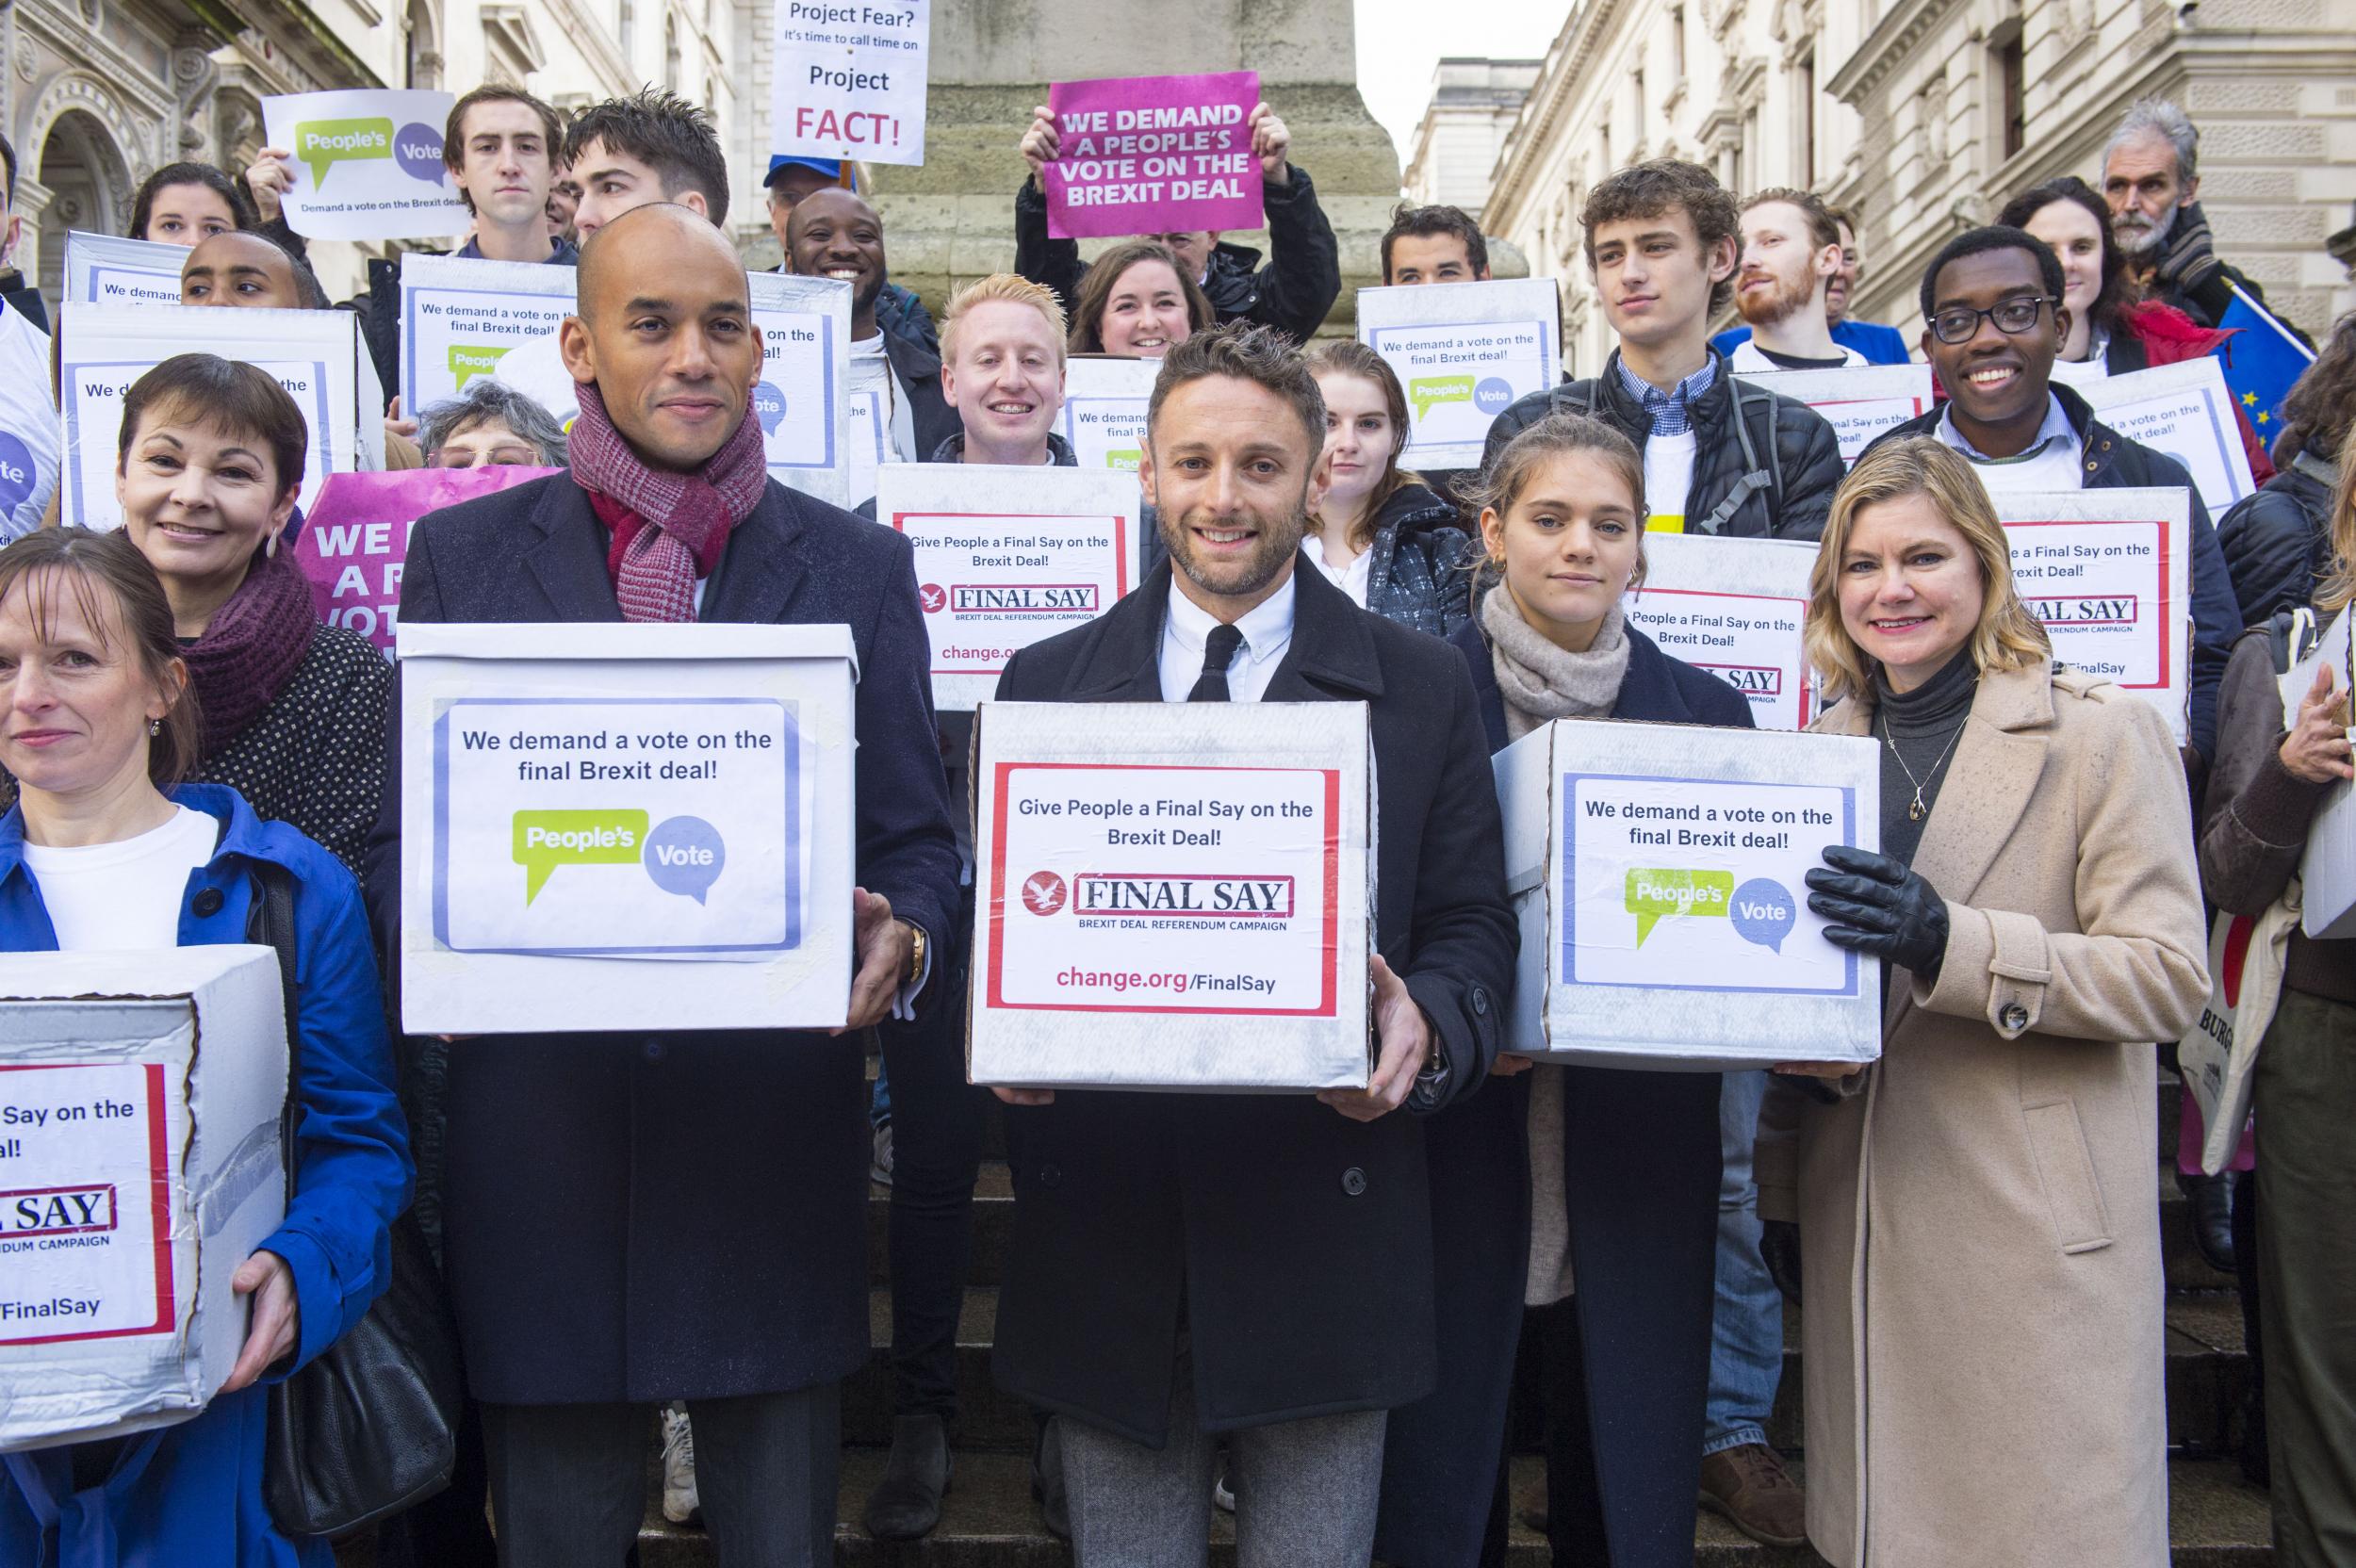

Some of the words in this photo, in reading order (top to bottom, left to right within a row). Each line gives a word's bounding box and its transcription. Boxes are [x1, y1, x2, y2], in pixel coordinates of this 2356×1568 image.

[791, 3, 856, 24] Project
[863, 8, 914, 27] Fear?
[785, 29, 801, 40] It's
[806, 30, 831, 42] time
[836, 34, 846, 44] to
[850, 36, 869, 45] call
[874, 37, 899, 48] time
[904, 41, 918, 50] on
[810, 66, 889, 91] Project
[796, 107, 899, 146] FACT!
[1062, 112, 1108, 133] WE
[1116, 105, 1242, 131] DEMAND
[305, 131, 385, 151] People's
[402, 143, 442, 159] Vote
[1074, 138, 1097, 156] A
[1104, 130, 1231, 155] PEOPLE'S
[1058, 159, 1136, 182] VOTE
[1143, 156, 1186, 177] ON
[1194, 154, 1249, 174] THE
[1067, 182, 1164, 206] BREXIT
[1171, 178, 1245, 201] DEAL
[302, 204, 343, 212] Demand
[354, 202, 376, 210] vote
[394, 200, 410, 208] the
[413, 198, 441, 208] Brexit
[444, 197, 466, 206] dea
[105, 285, 125, 296] We
[422, 303, 442, 314] We
[446, 305, 497, 318] demand
[514, 310, 539, 320] vote
[450, 321, 478, 332] final
[483, 322, 520, 334] Brexit
[767, 330, 786, 340] on
[792, 329, 814, 341] the
[1383, 342, 1401, 351] We
[1406, 339, 1452, 351] demand
[1467, 337, 1493, 347] vote
[1497, 336, 1511, 345] on
[1515, 335, 1533, 344] the
[763, 348, 780, 358] al!
[1411, 354, 1436, 365] final
[1440, 352, 1475, 363] Brexit
[1479, 351, 1507, 361] deal!
[86, 384, 112, 397] We
[1417, 384, 1469, 397] People's
[1479, 391, 1508, 401] Vote
[755, 400, 779, 412] ote
[2130, 415, 2157, 426] vote
[2161, 411, 2176, 419] on
[2181, 405, 2201, 416] the
[1079, 414, 1098, 422] We
[1853, 418, 1871, 427] Say
[1891, 415, 1909, 423] the
[1107, 428, 1133, 436] final
[2146, 424, 2176, 438] deal!
[0, 461, 24, 483] te
[315, 522, 392, 558] WE
[911, 537, 940, 547] Give
[944, 537, 989, 549] People
[1005, 537, 1036, 547] Final
[1039, 537, 1061, 549] Say
[1088, 537, 1108, 547] the
[973, 555, 1011, 566] Brexit
[1016, 555, 1049, 566] Deal!
[2036, 547, 2070, 558] Final
[2073, 546, 2100, 558] Say
[2104, 547, 2121, 555] on
[2126, 544, 2150, 555] the
[2048, 565, 2084, 577] Deal!
[332, 565, 369, 597] A
[958, 589, 1038, 608] FINAL
[1045, 589, 1090, 608] SAY
[2079, 600, 2129, 619] SAY
[1632, 612, 1677, 624] People
[1680, 616, 1687, 625] a
[1692, 615, 1723, 627] Final
[1726, 617, 1750, 630] Say
[1755, 621, 1770, 629] on
[1775, 620, 1794, 631] the
[1660, 632, 1697, 645] Brexit
[1701, 634, 1734, 646] Deal!
[1728, 670, 1774, 690] SAY
[463, 731, 499, 749] We
[509, 730, 607, 750] demand
[615, 736, 628, 749] a
[636, 731, 688, 749] vote
[697, 734, 726, 749] on
[735, 730, 772, 749] the
[518, 761, 569, 780] final
[580, 760, 652, 779] Brexit
[660, 760, 717, 779] deal!
[1019, 799, 1061, 816] Give
[1069, 799, 1133, 819] People
[1139, 804, 1150, 816] a
[1156, 799, 1203, 816] Final
[1209, 800, 1244, 821] Say
[1252, 805, 1274, 817] on
[1281, 801, 1313, 818] the
[1586, 801, 1615, 817] We
[1623, 804, 1700, 820] demand
[1707, 808, 1717, 820] a
[1724, 808, 1765, 823] vote
[1772, 810, 1795, 824] on
[1803, 808, 1833, 825] the
[527, 826, 634, 853] People's
[656, 845, 713, 866] Vote
[1107, 829, 1166, 845] Brexit
[1172, 829, 1221, 846] Deal!
[1629, 828, 1670, 844] final
[1678, 830, 1736, 846] Brexit
[1742, 833, 1789, 848] deal!
[1086, 880, 1203, 909] FINAL
[1213, 883, 1284, 911] SAY
[1636, 882, 1723, 905] People's
[1741, 902, 1786, 920] Vote
[1079, 920, 1116, 928] BREXIT
[1121, 920, 1148, 930] DEAL
[1152, 920, 1226, 931] REFERENDUM
[1230, 922, 1287, 931] CAMPAIGN
[4, 1106, 48, 1127] Say
[57, 1105, 86, 1120] on
[94, 1101, 134, 1118] the
[0, 1139, 20, 1157] al!
[16, 1194, 102, 1230] SAY
[39, 1235, 110, 1251] CAMPAIGN
